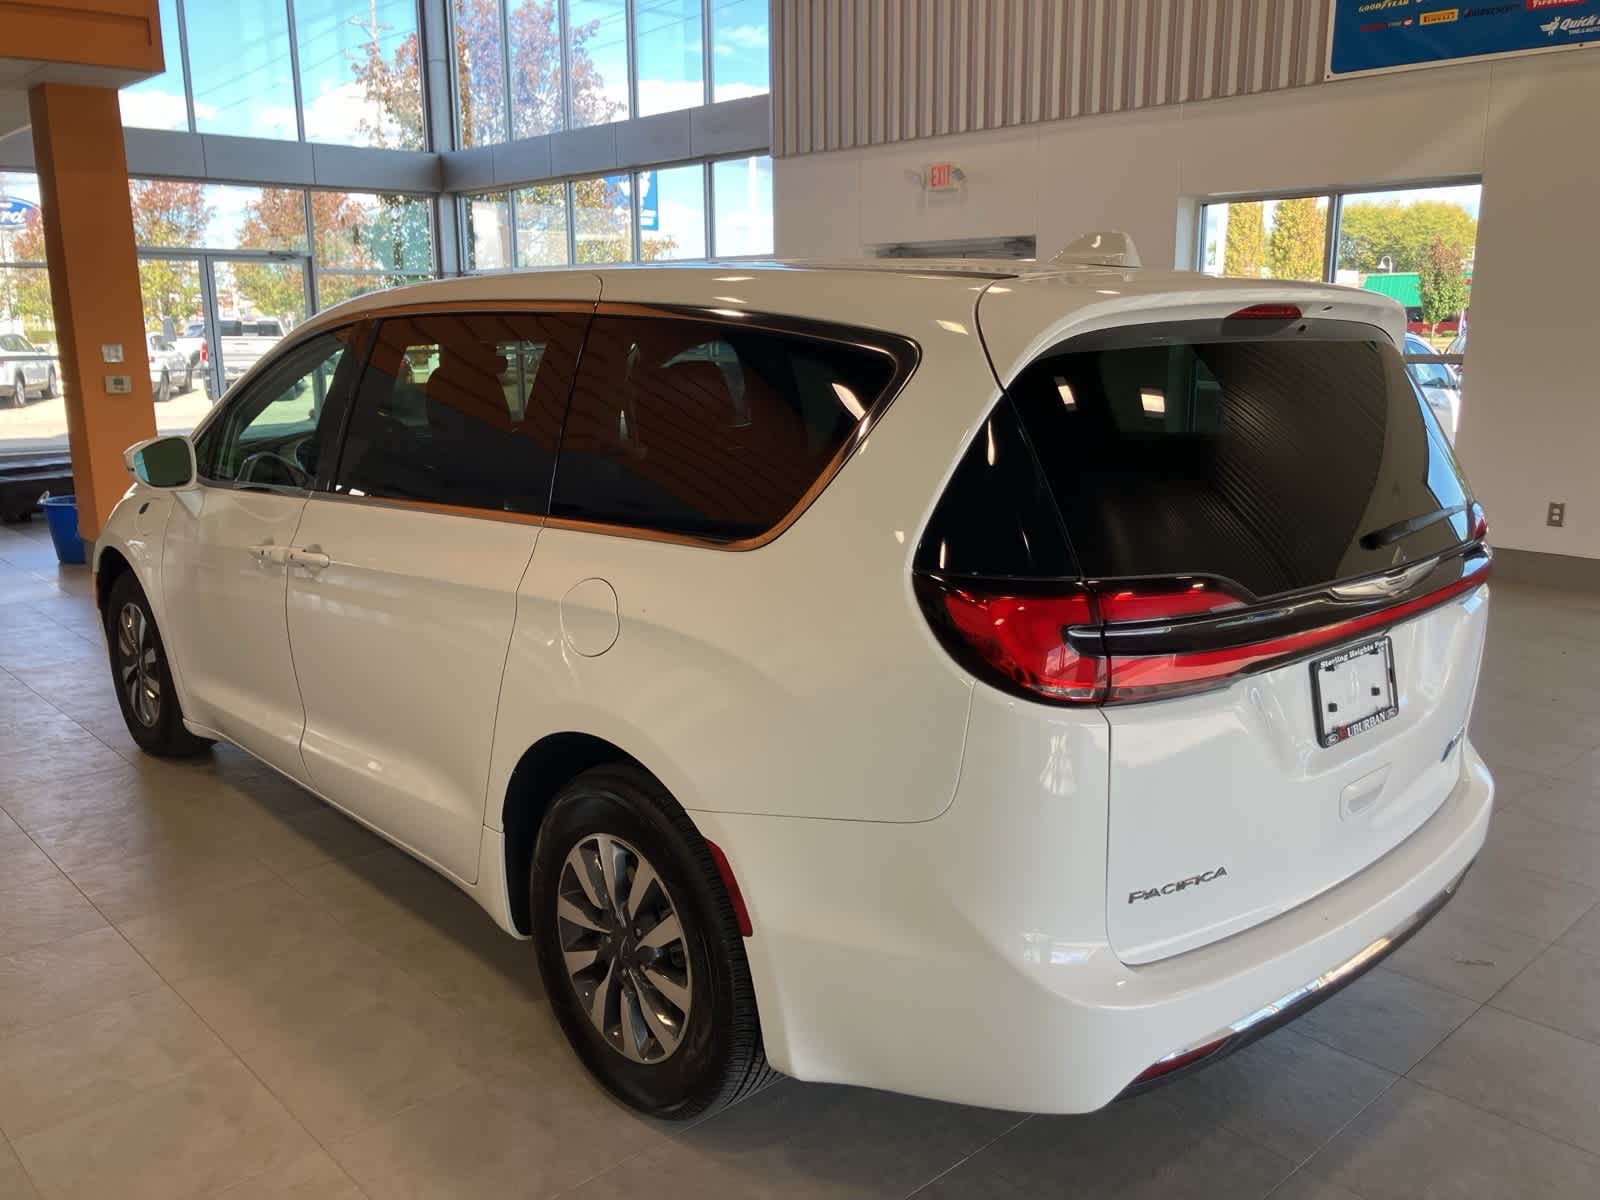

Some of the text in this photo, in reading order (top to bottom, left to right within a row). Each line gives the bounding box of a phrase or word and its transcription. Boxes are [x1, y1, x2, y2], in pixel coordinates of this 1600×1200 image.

[1560, 15, 1597, 31] Quick
[1320, 654, 1349, 667] Sterling
[1349, 644, 1374, 658] Heights
[1128, 866, 1227, 904] PACIFICA
